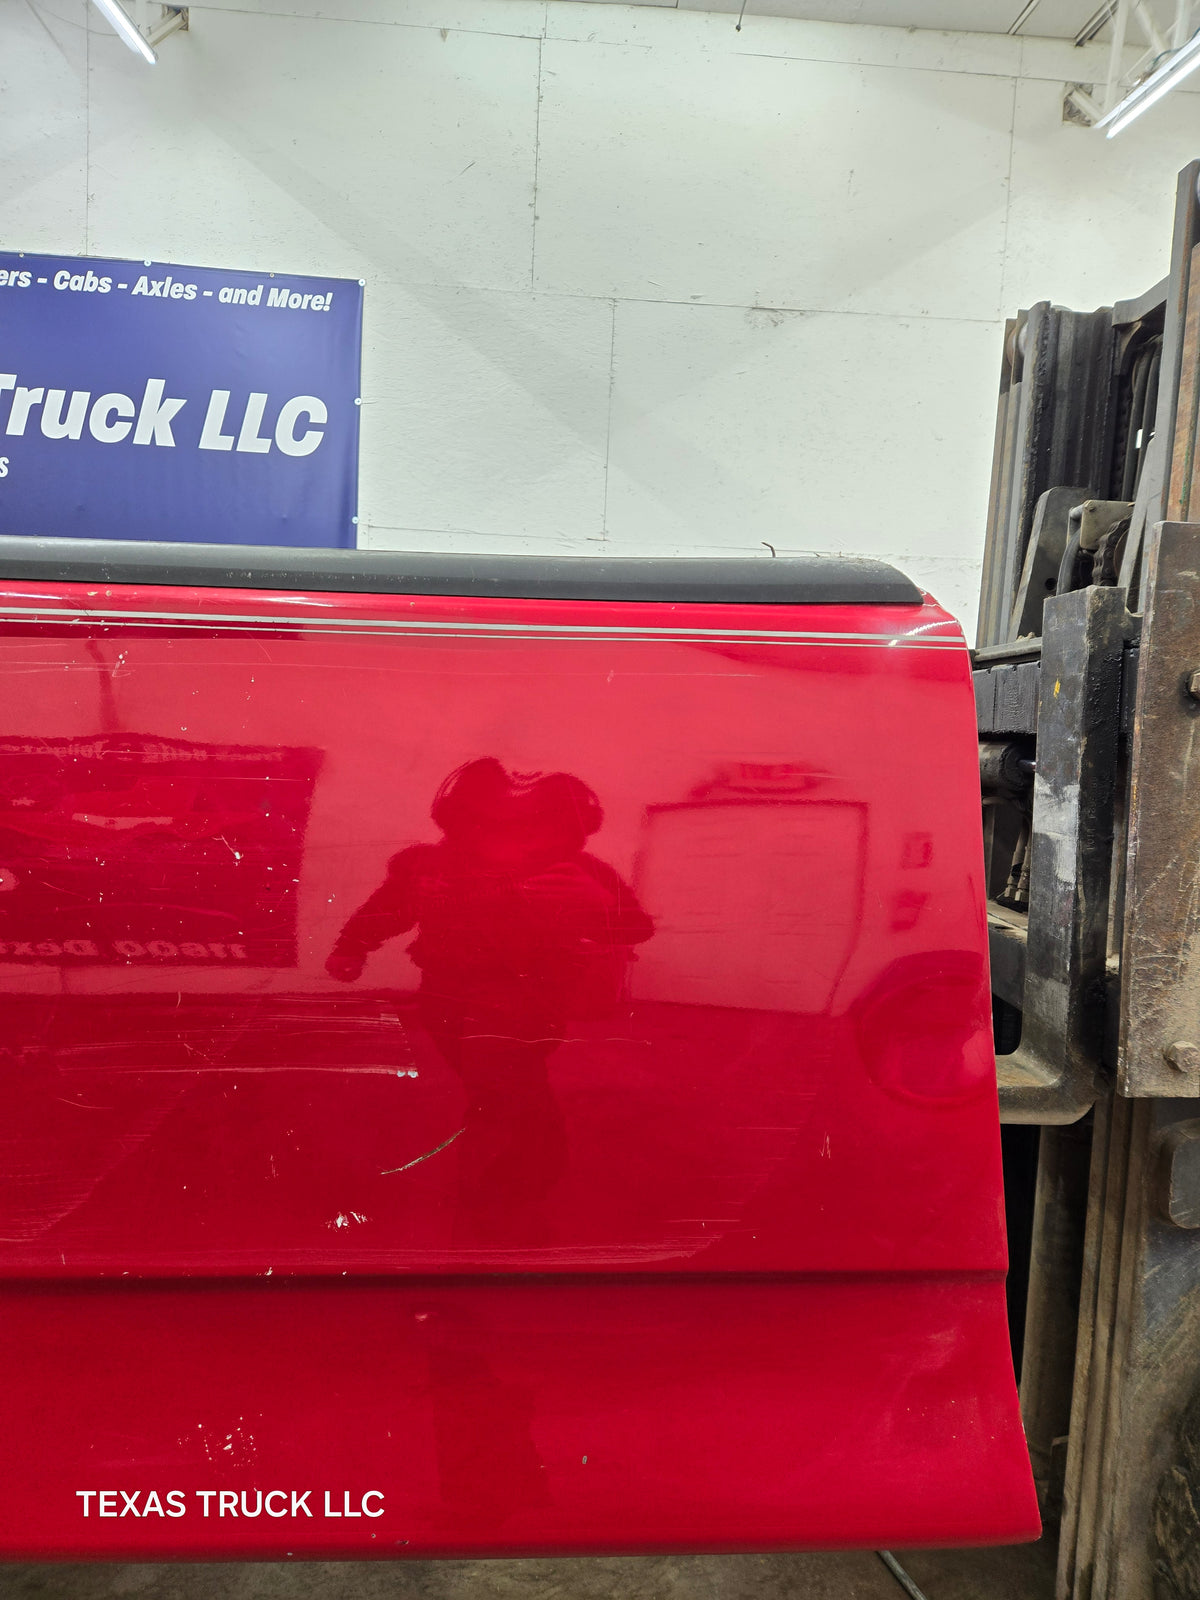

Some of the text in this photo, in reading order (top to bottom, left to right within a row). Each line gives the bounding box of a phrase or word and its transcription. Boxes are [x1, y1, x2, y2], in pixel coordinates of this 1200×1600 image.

[53, 270, 113, 294] Cabs
[131, 275, 198, 301] Axles
[218, 284, 264, 306] and
[266, 287, 334, 312] More!
[198, 389, 329, 457] LLC
